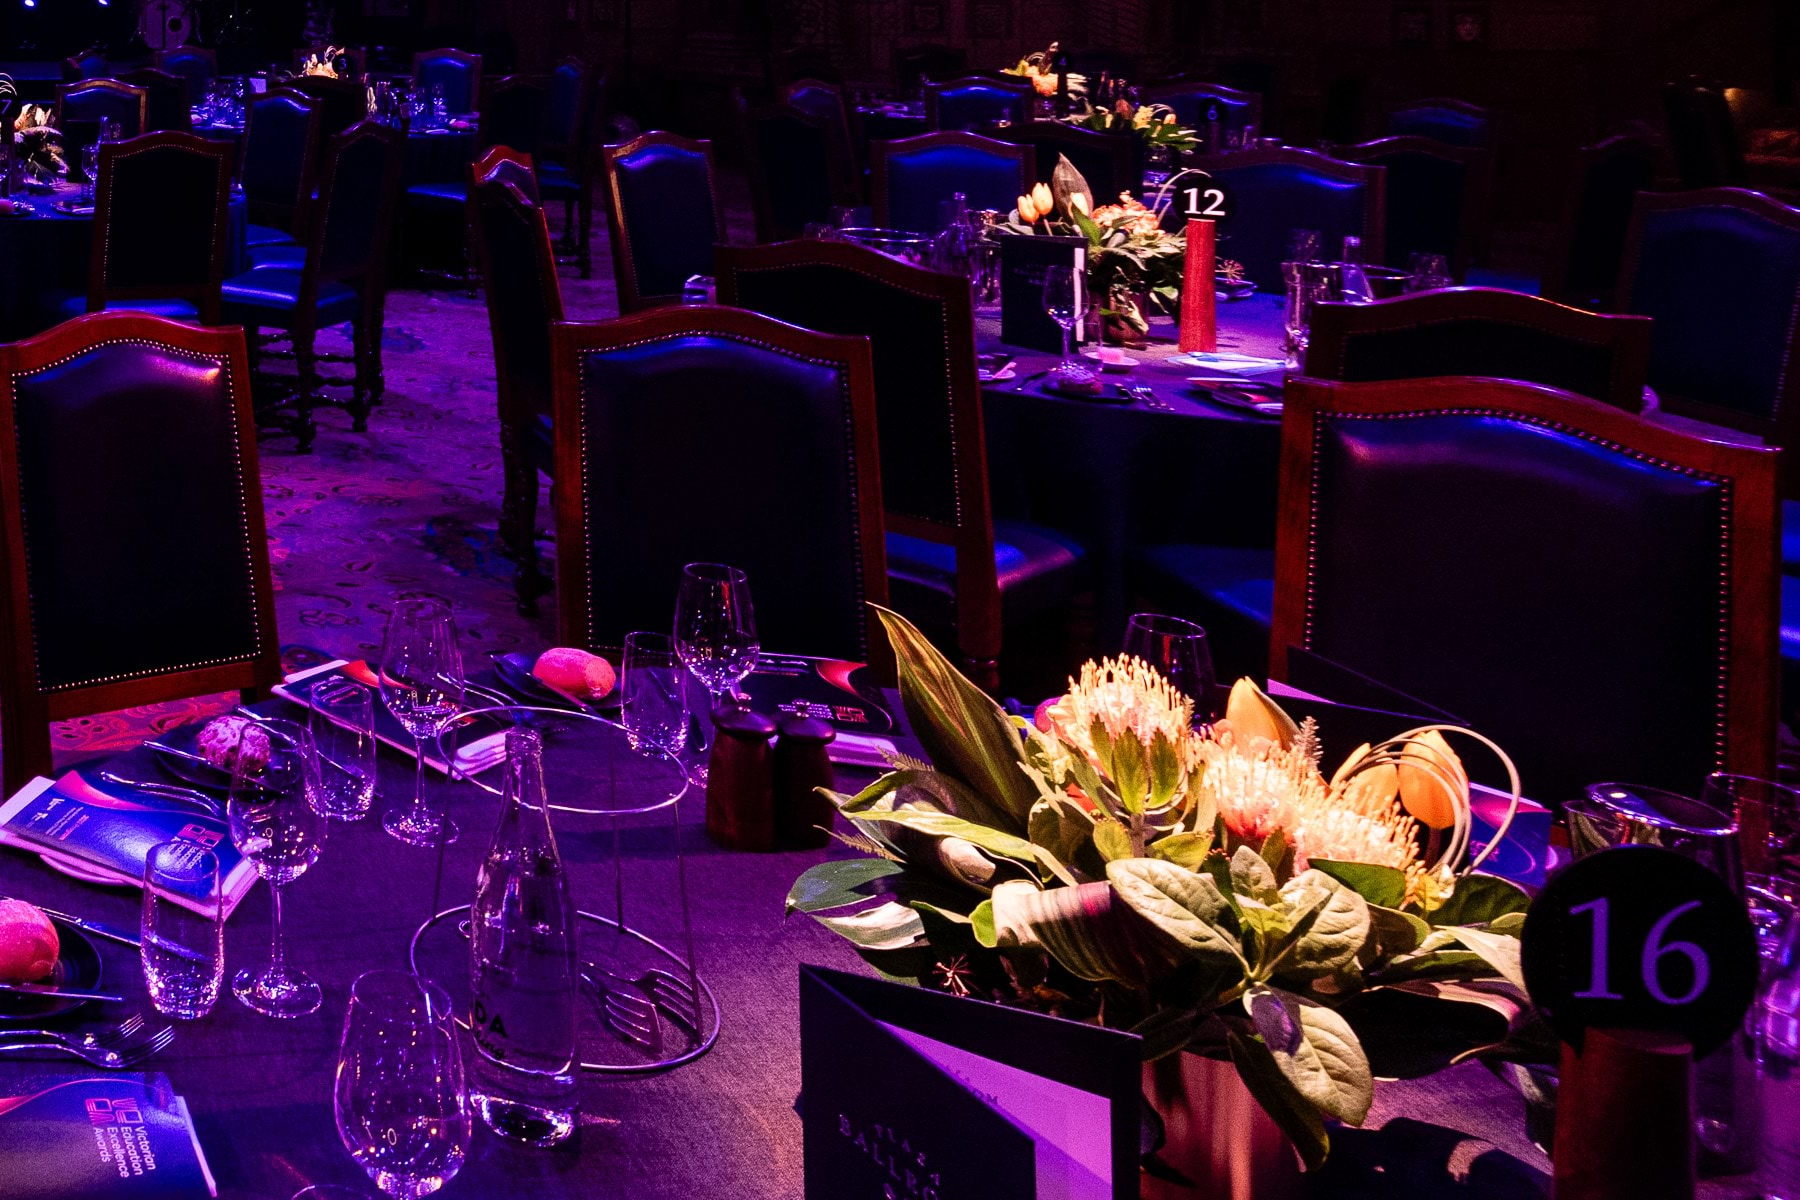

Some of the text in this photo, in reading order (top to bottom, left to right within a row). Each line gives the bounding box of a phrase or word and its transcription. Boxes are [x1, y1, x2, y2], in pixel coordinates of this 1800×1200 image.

[339, 57, 347, 70] 3
[0, 99, 12, 115] 7
[1207, 105, 1218, 121] 6
[1183, 188, 1226, 216] 12
[1569, 897, 1711, 1005] 16
[93, 1127, 111, 1163] Awards
[107, 1126, 130, 1178] Excellence
[120, 1126, 143, 1176] Education
[134, 1125, 156, 1171] Victorian
[874, 1124, 940, 1187] PLAZA
